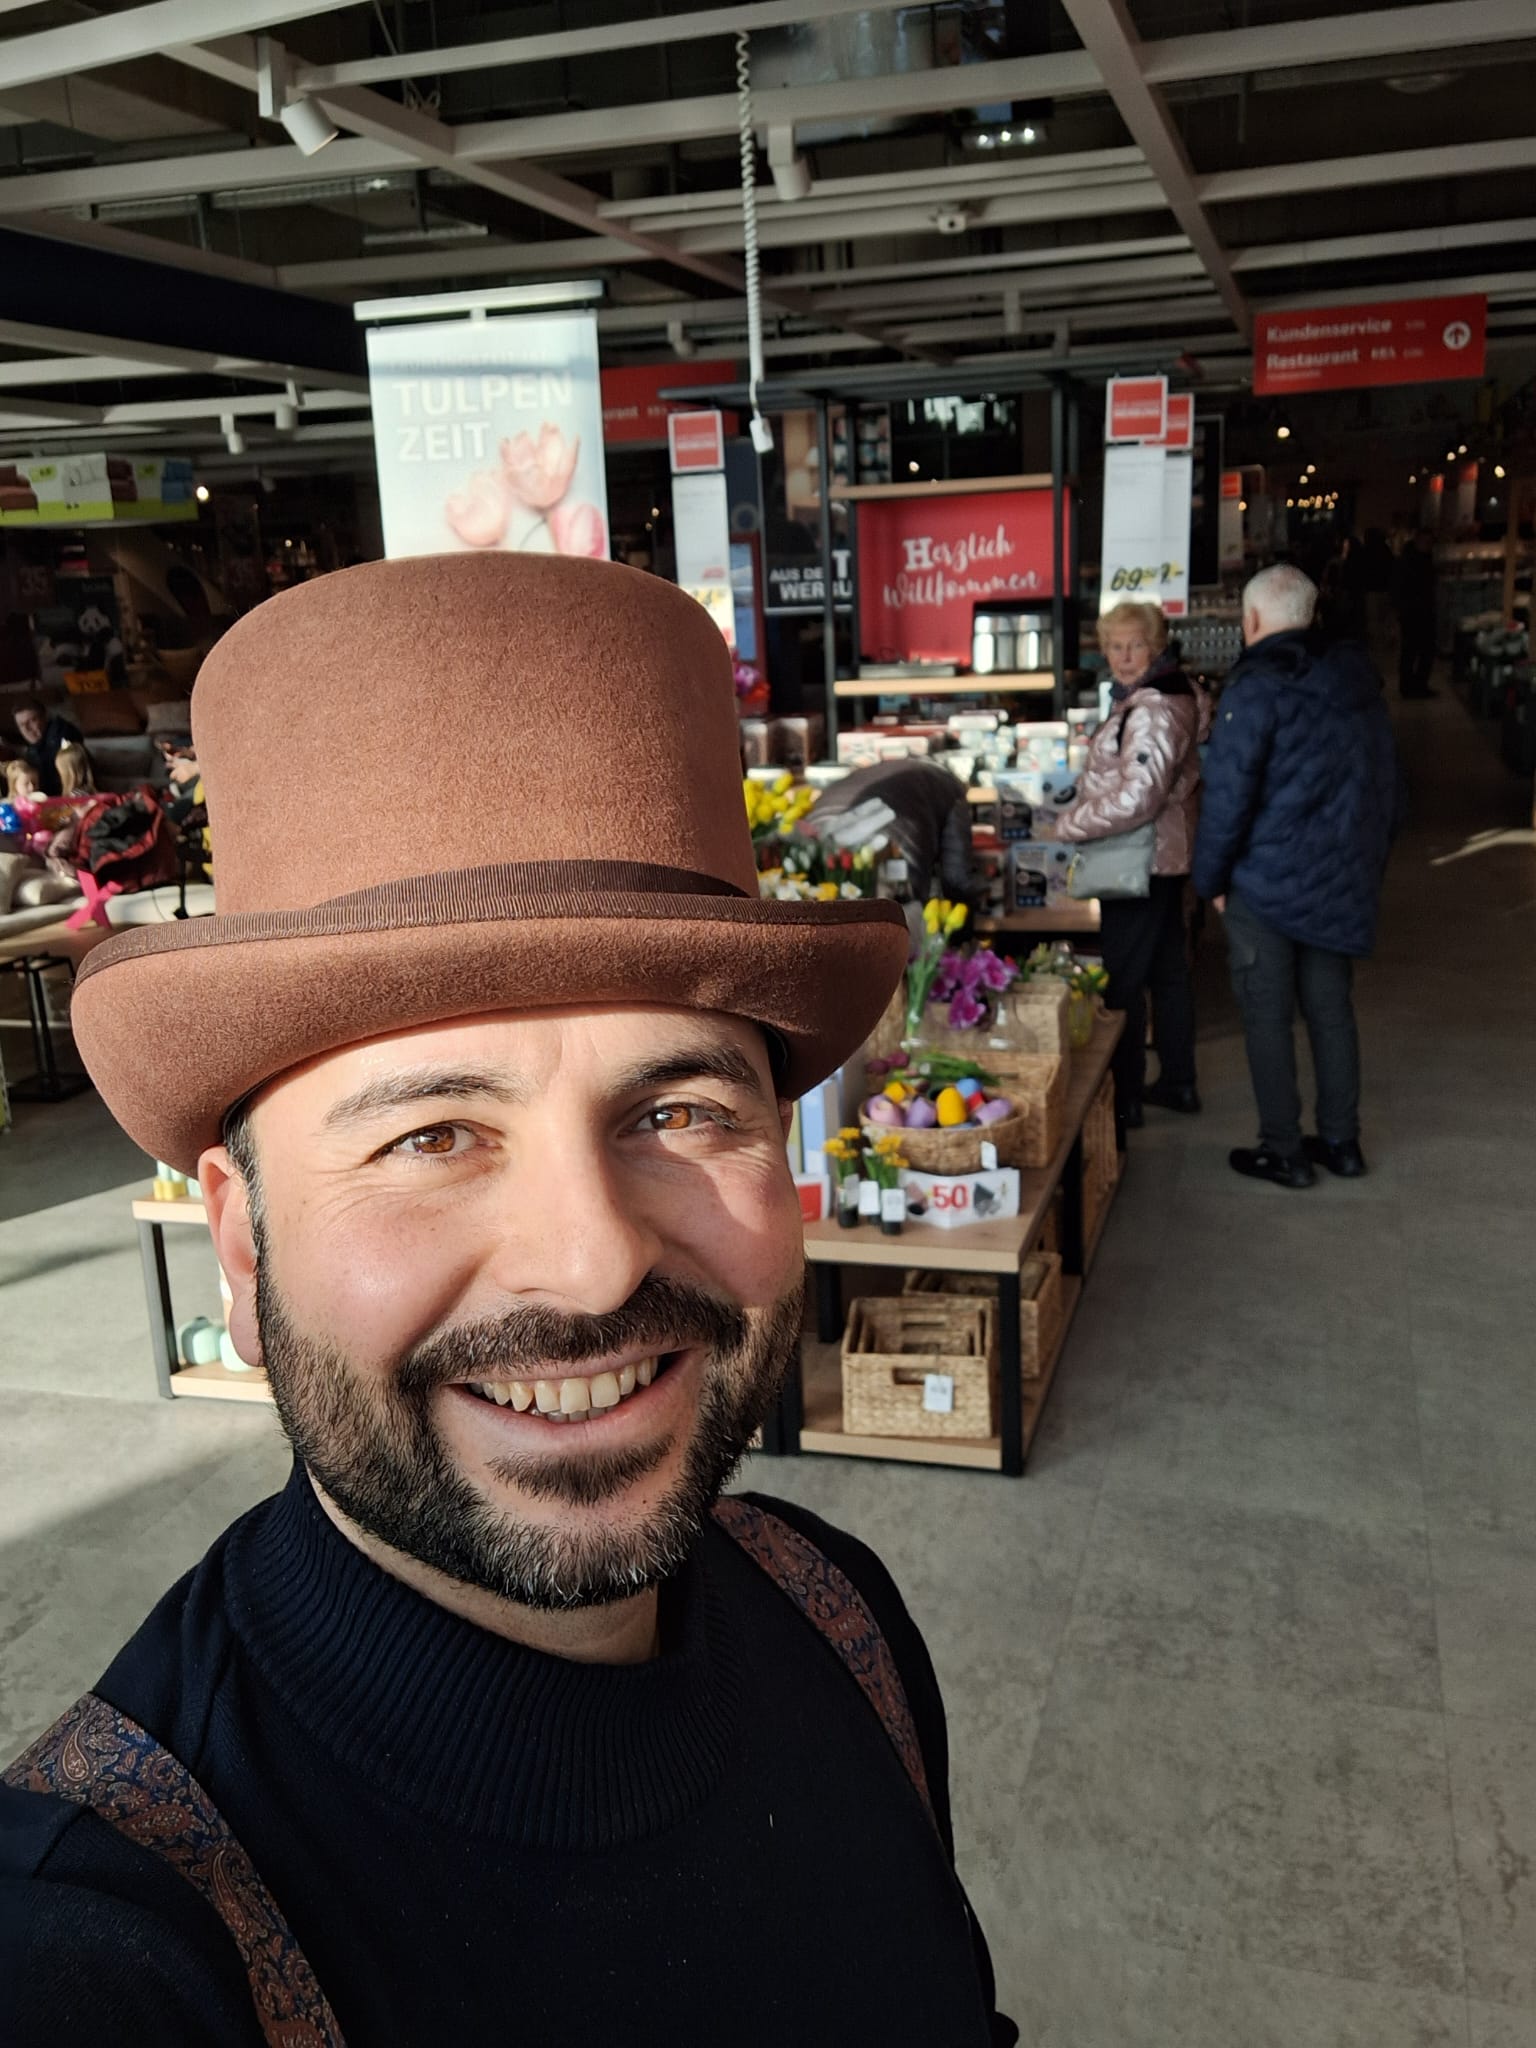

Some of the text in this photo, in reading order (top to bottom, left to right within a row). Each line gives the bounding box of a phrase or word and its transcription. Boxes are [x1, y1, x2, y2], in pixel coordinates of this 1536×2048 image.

[1266, 318, 1392, 343] Kundenservice
[1266, 348, 1359, 371] Restaurant
[392, 371, 573, 417] TULPEN
[397, 421, 490, 462] ZEIT
[902, 524, 1014, 573] Herzlich
[769, 568, 801, 582] AUS
[804, 566, 824, 580] DE
[883, 570, 1041, 609] Willkommen
[932, 1184, 969, 1211] 50
